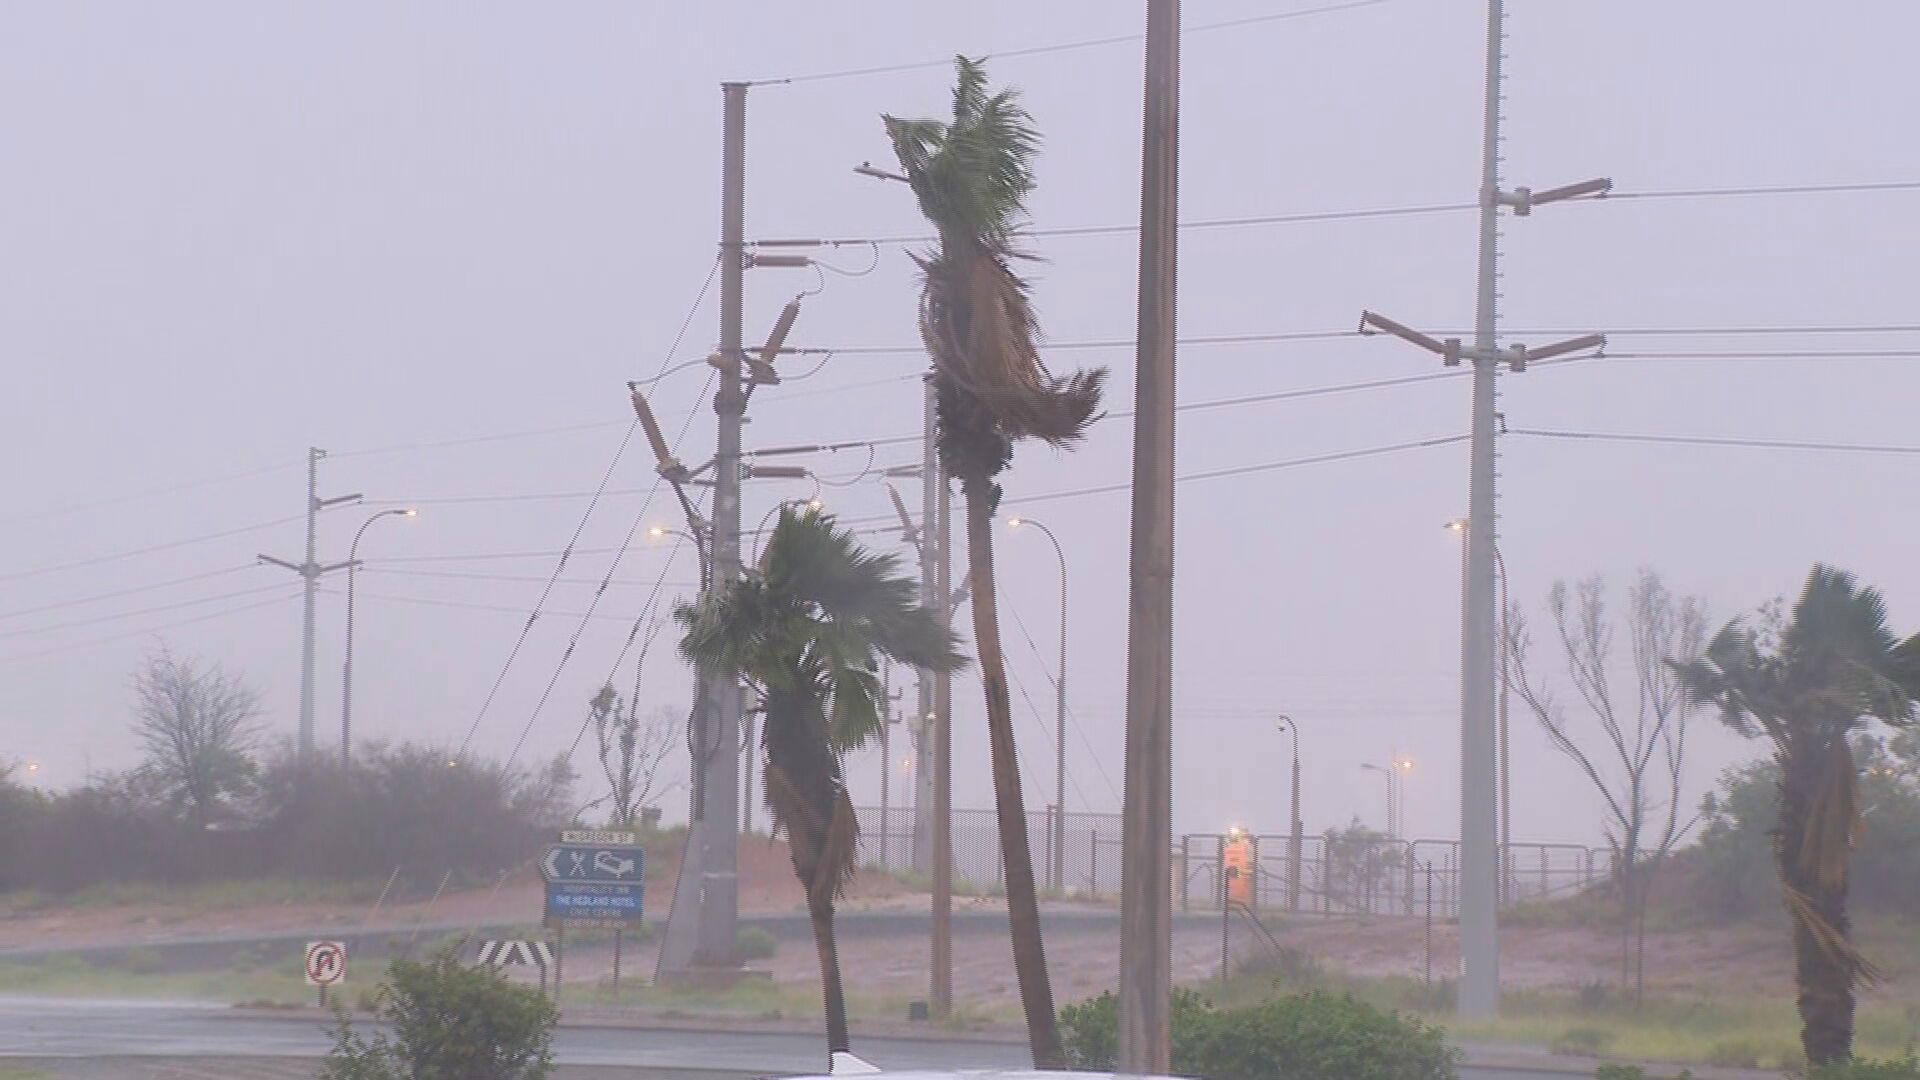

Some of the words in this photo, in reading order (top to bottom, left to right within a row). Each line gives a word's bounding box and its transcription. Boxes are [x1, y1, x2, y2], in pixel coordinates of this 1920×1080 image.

[556, 896, 571, 905] THE
[573, 896, 609, 906] HEDLAND
[611, 897, 634, 907] HOTEL
[592, 909, 621, 918] CENTRE
